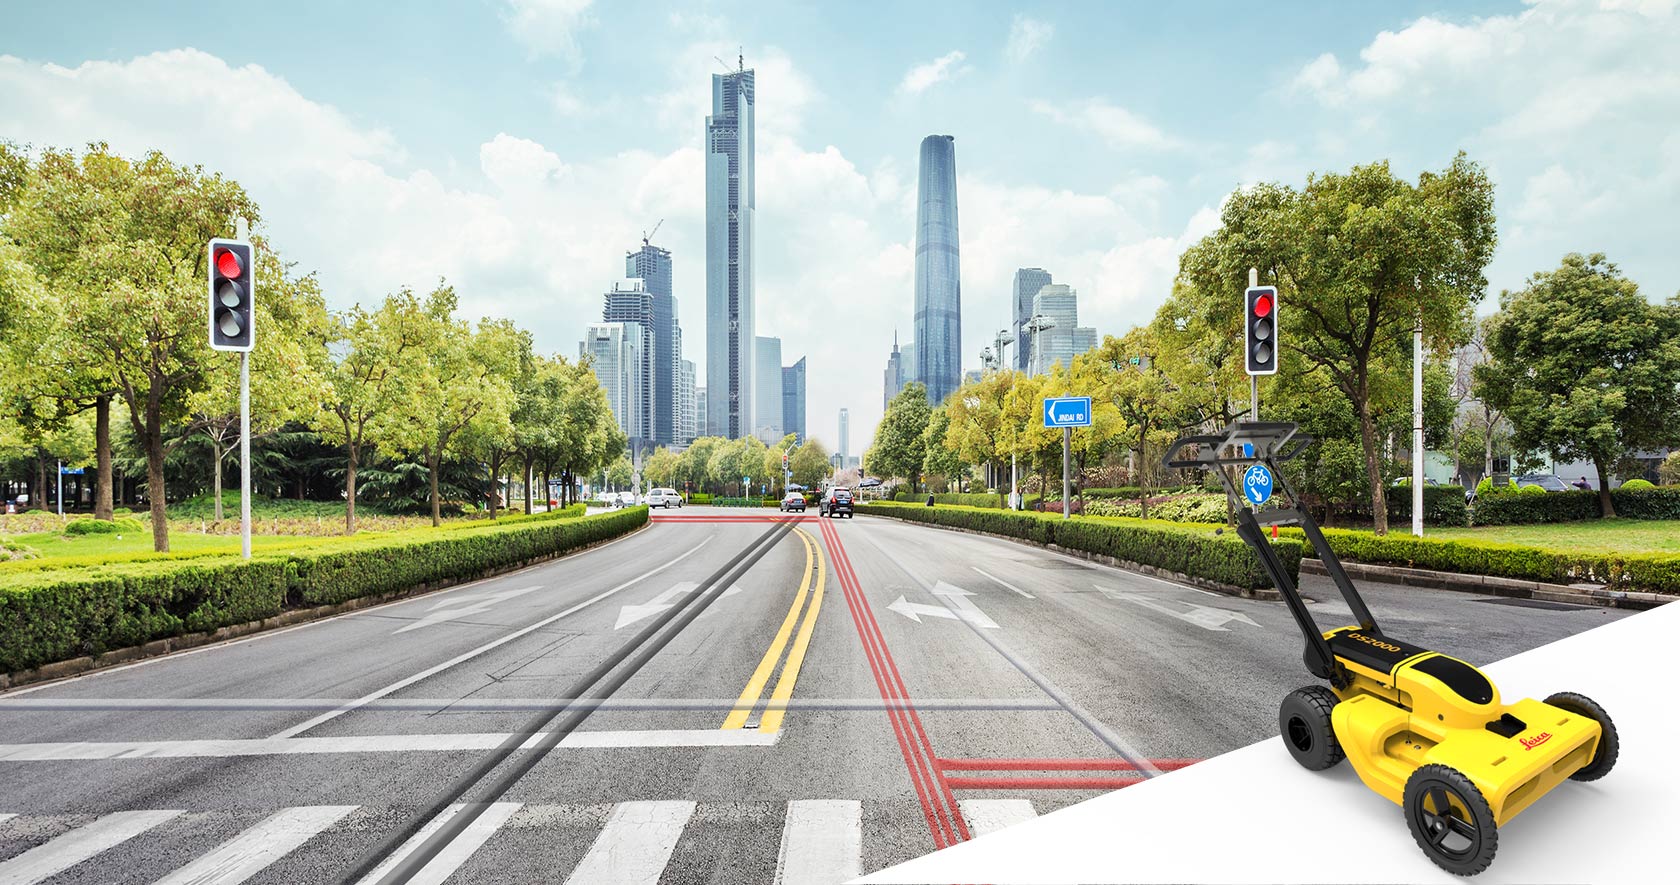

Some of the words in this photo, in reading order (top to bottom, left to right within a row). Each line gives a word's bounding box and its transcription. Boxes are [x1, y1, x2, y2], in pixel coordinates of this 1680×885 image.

[1058, 413, 1075, 422] JINDAI
[1076, 413, 1084, 421] RD
[1348, 632, 1401, 652] DS2000
[1519, 732, 1552, 751] Leica
